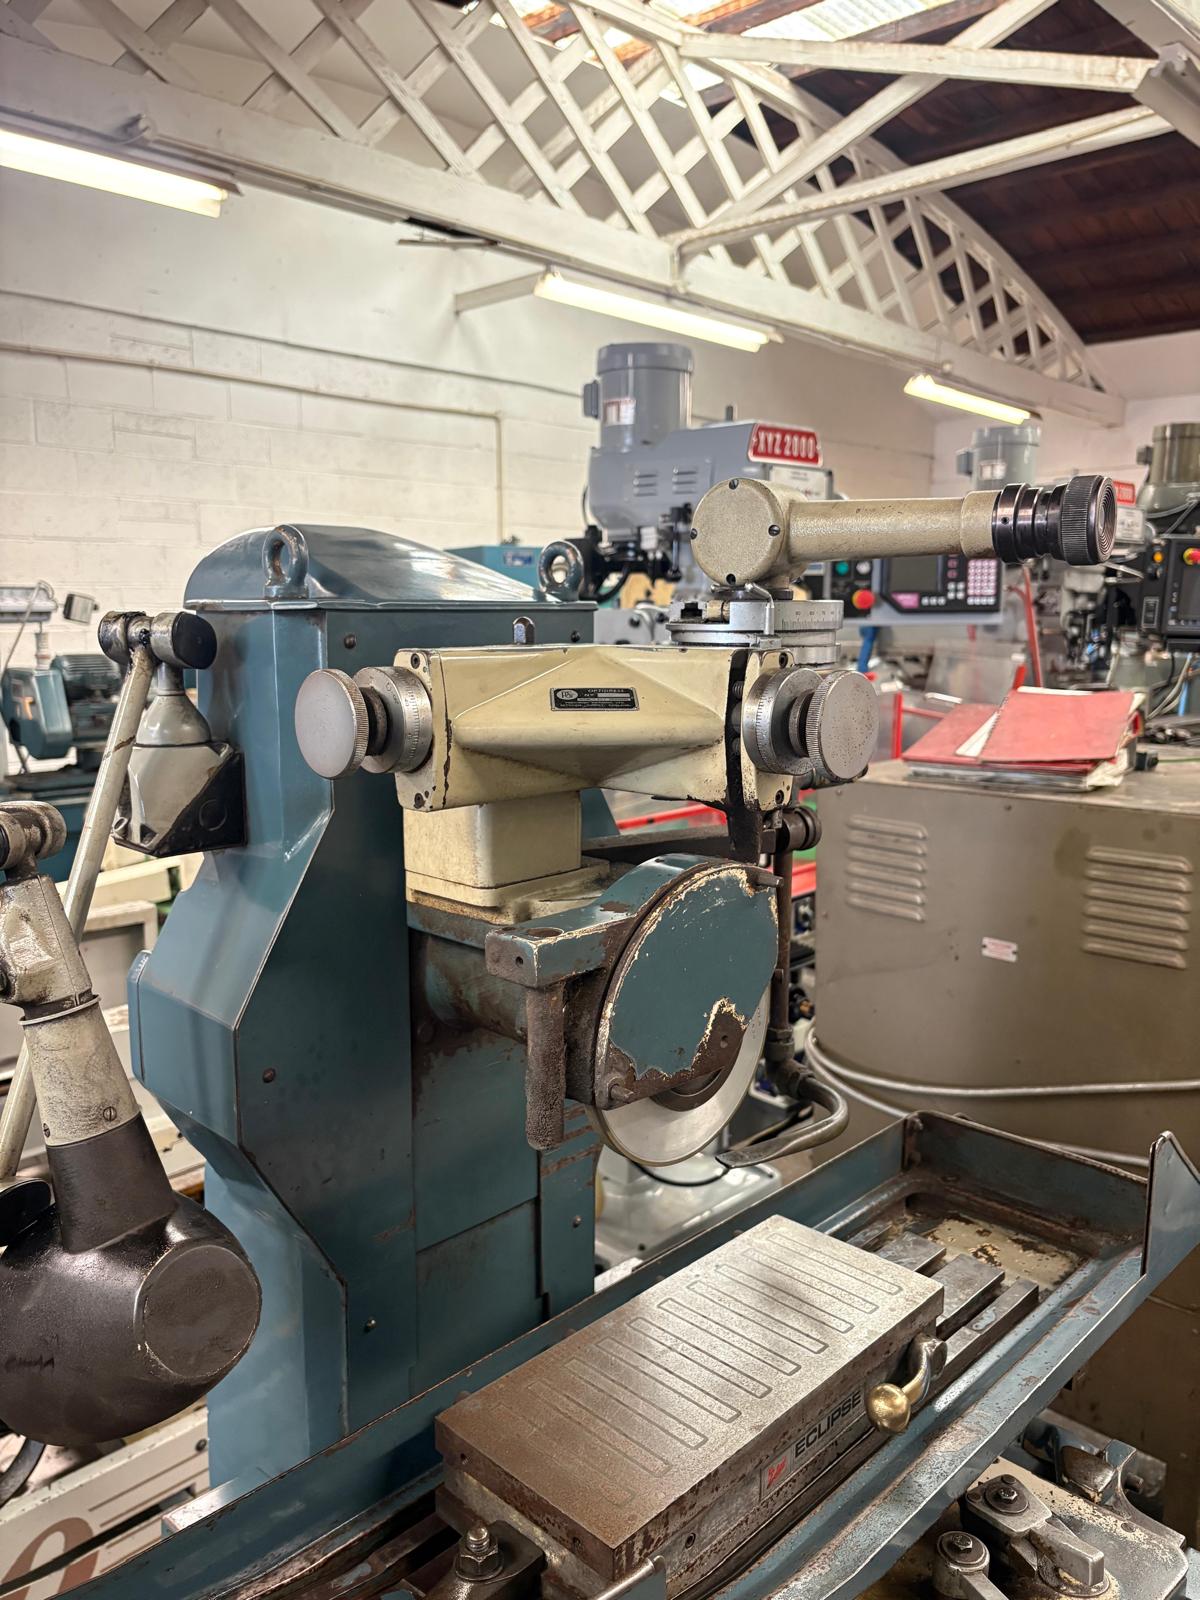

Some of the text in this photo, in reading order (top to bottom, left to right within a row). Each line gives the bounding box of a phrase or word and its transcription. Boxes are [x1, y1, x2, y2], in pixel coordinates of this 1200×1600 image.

[758, 430, 816, 459] XYZ 2000
[794, 1390, 861, 1458] ECLIPSE
